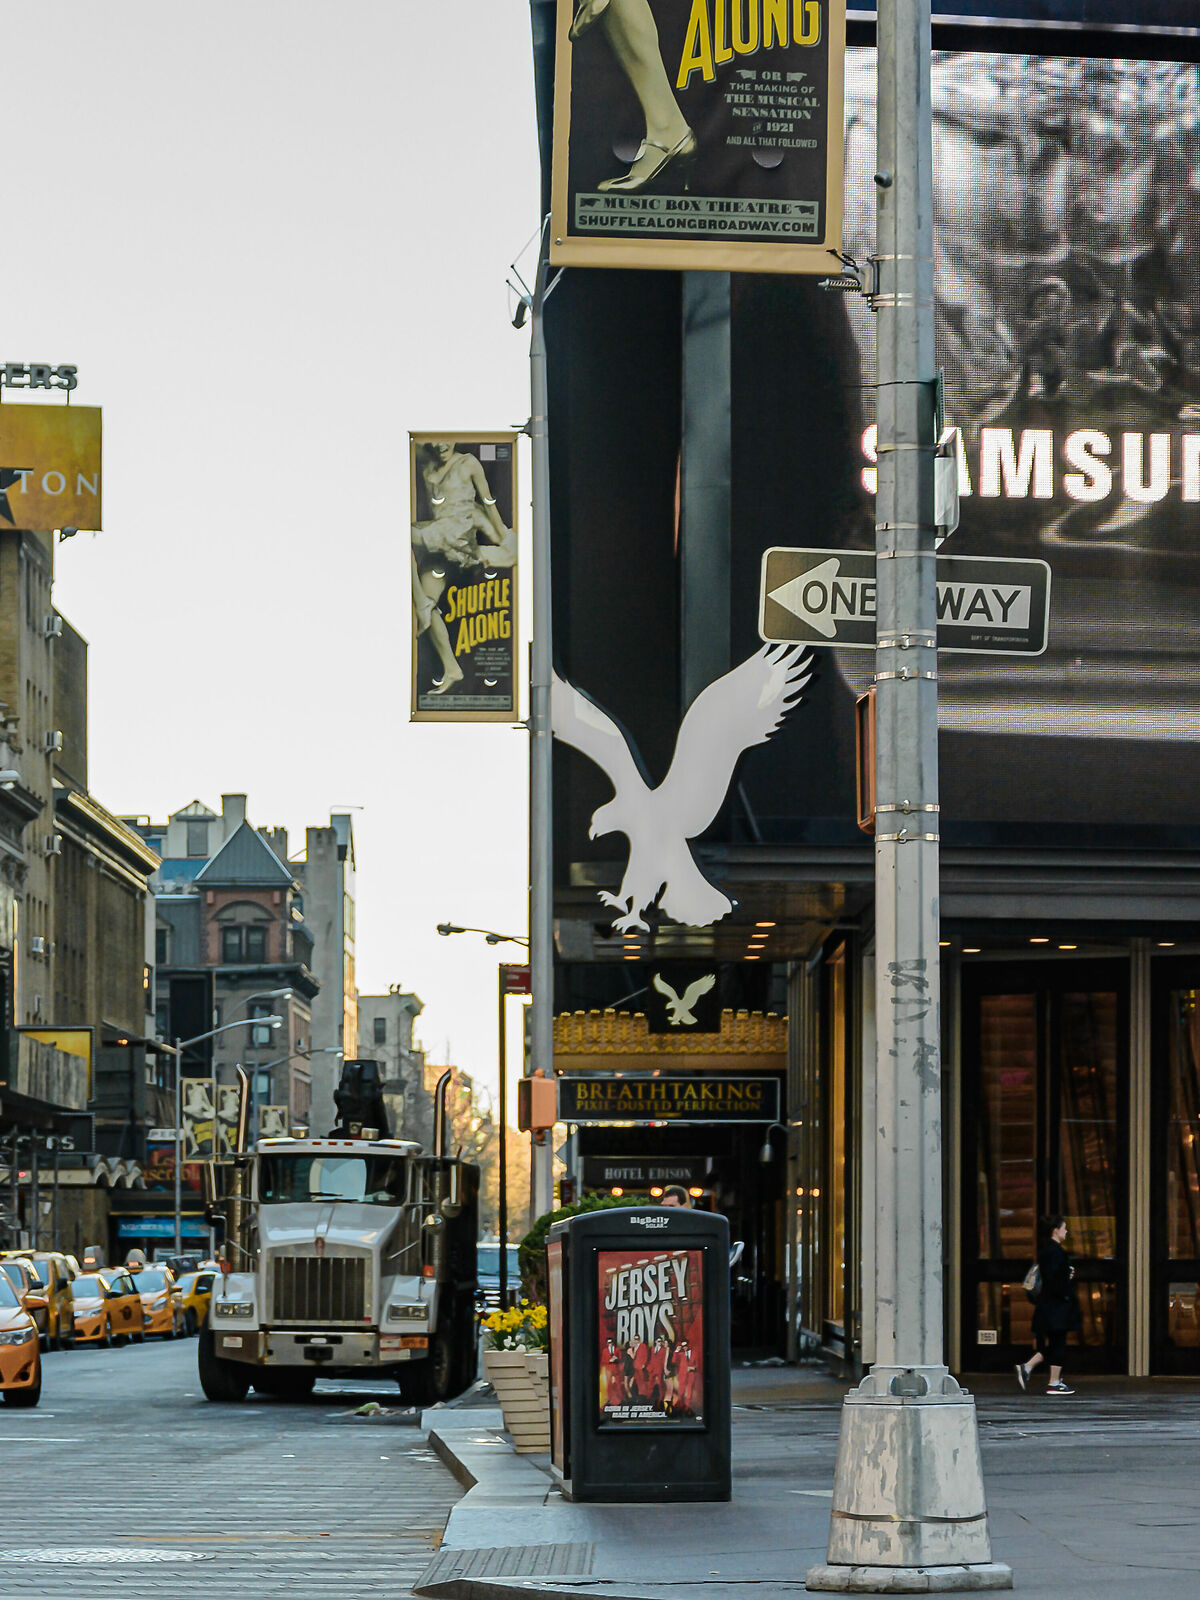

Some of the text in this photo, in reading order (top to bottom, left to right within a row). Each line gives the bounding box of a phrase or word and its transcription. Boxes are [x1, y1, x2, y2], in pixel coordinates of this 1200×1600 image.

[676, 0, 820, 90] ALONG
[761, 71, 781, 81] OR
[729, 82, 815, 94] THE MAKING OF
[724, 93, 820, 107] THE MUSICAL
[732, 107, 811, 120] SENSATION
[766, 122, 794, 132] 1921
[726, 136, 818, 148] AND ALL THAT FOLLOWED
[603, 197, 793, 215] MUSIC BOX THEATRE
[578, 215, 815, 233] SHUFFLEALONGBROADWAY.COM
[445, 578, 510, 624] SHUFFLE
[802, 580, 1022, 624] ONE WAY
[455, 609, 511, 657] ALONG
[576, 1082, 762, 1100] BREATHTAKING
[676, 1100, 761, 1111] PERFECTION
[604, 1167, 692, 1180] HOTEL EDISON
[604, 1256, 689, 1311] JERSEY
[616, 1300, 676, 1348] BOYS
